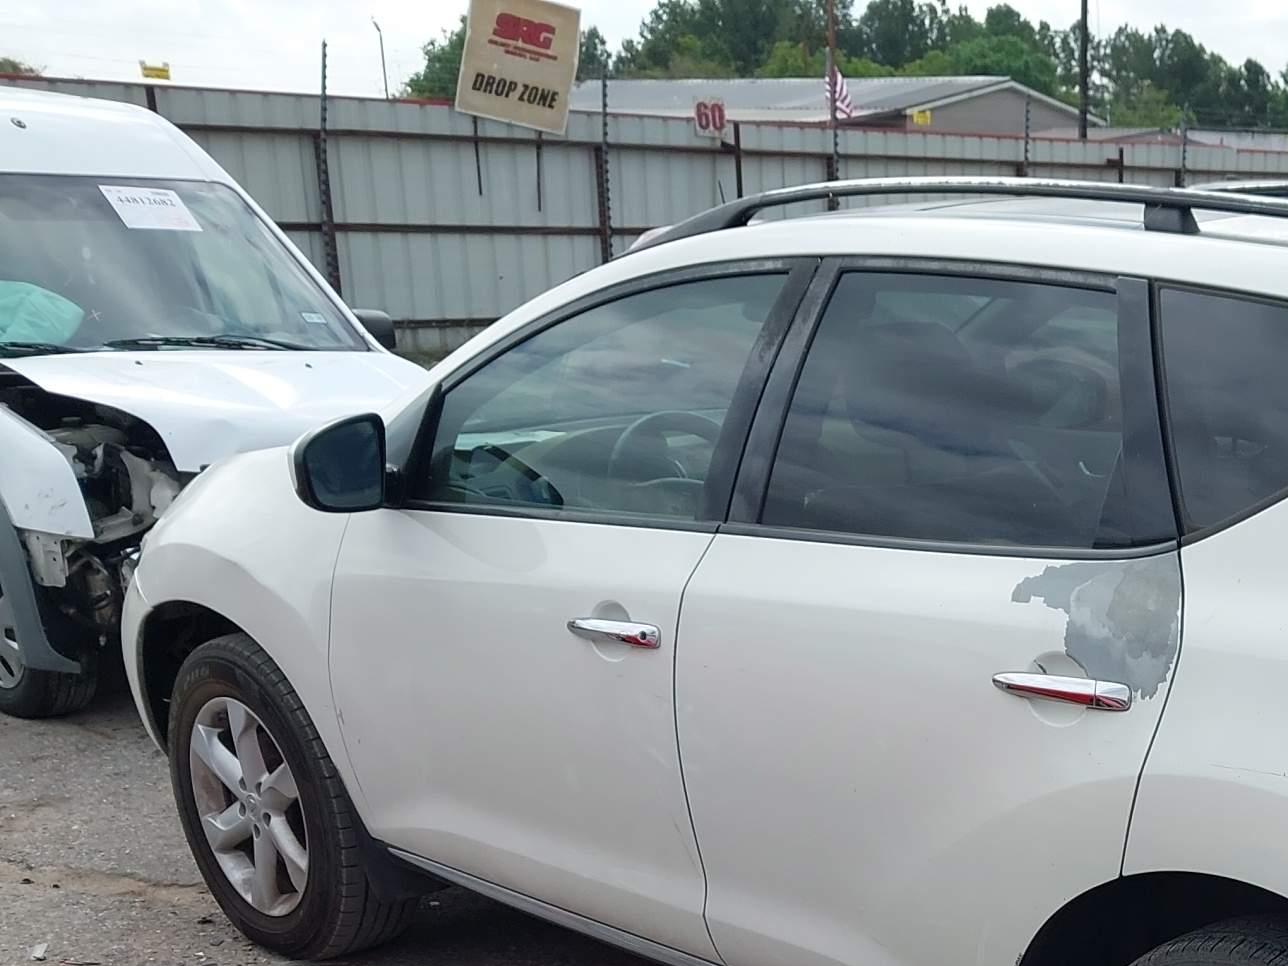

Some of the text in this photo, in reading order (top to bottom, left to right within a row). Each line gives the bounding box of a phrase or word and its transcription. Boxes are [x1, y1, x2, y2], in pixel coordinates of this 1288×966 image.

[492, 12, 556, 50] SRG
[471, 72, 560, 110] DROP ZONE
[696, 102, 726, 130] 60
